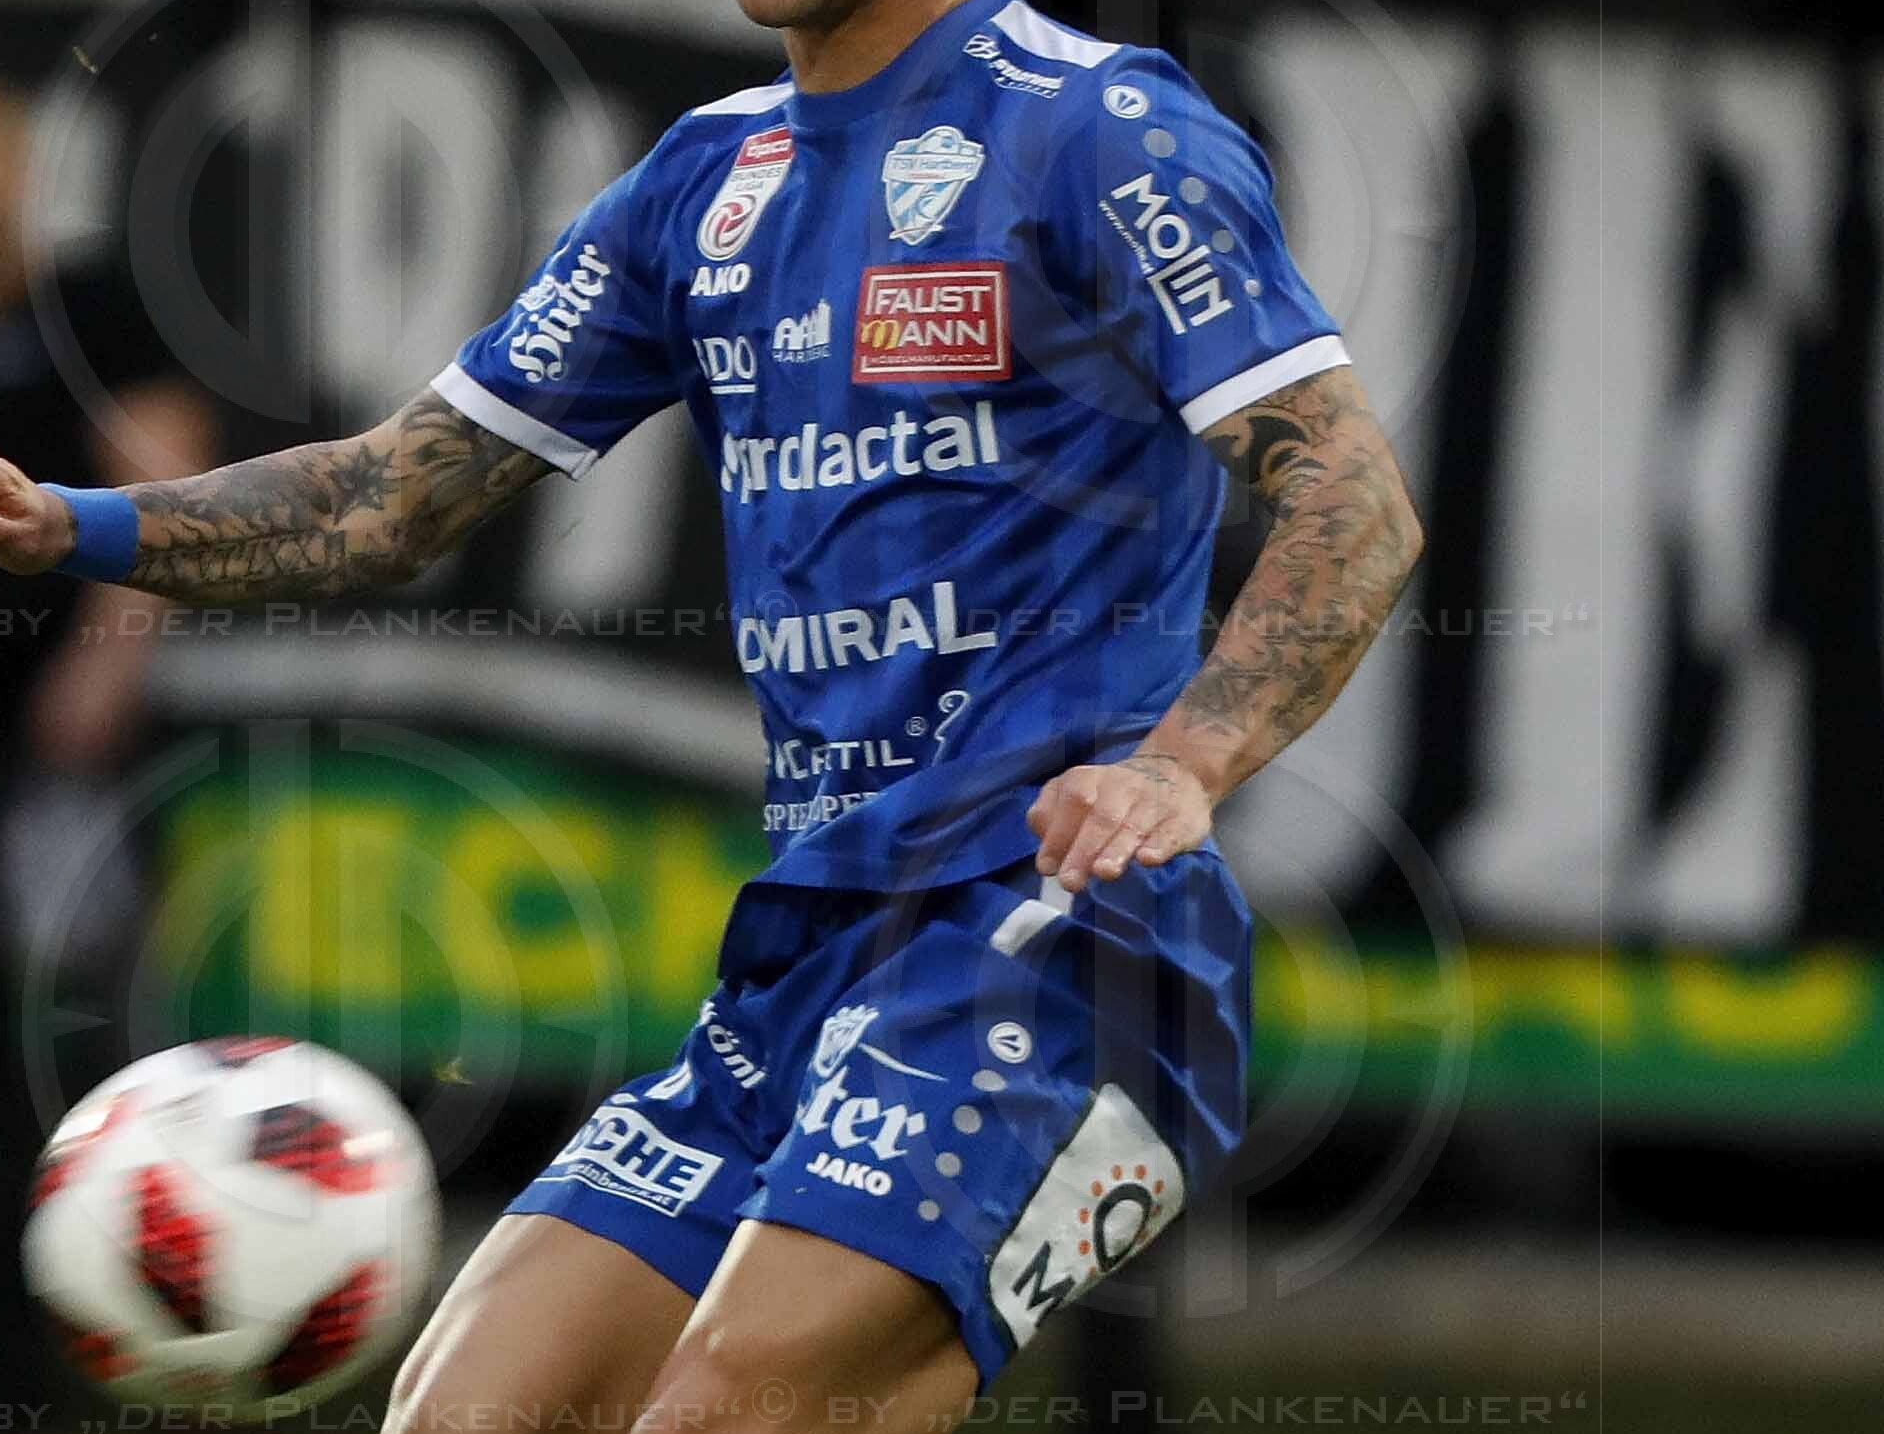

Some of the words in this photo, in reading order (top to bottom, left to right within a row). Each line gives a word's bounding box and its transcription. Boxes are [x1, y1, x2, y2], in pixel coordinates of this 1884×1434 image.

[689, 263, 752, 297] AKO
[873, 284, 992, 315] FAUST
[805, 1152, 893, 1197] JAKO
